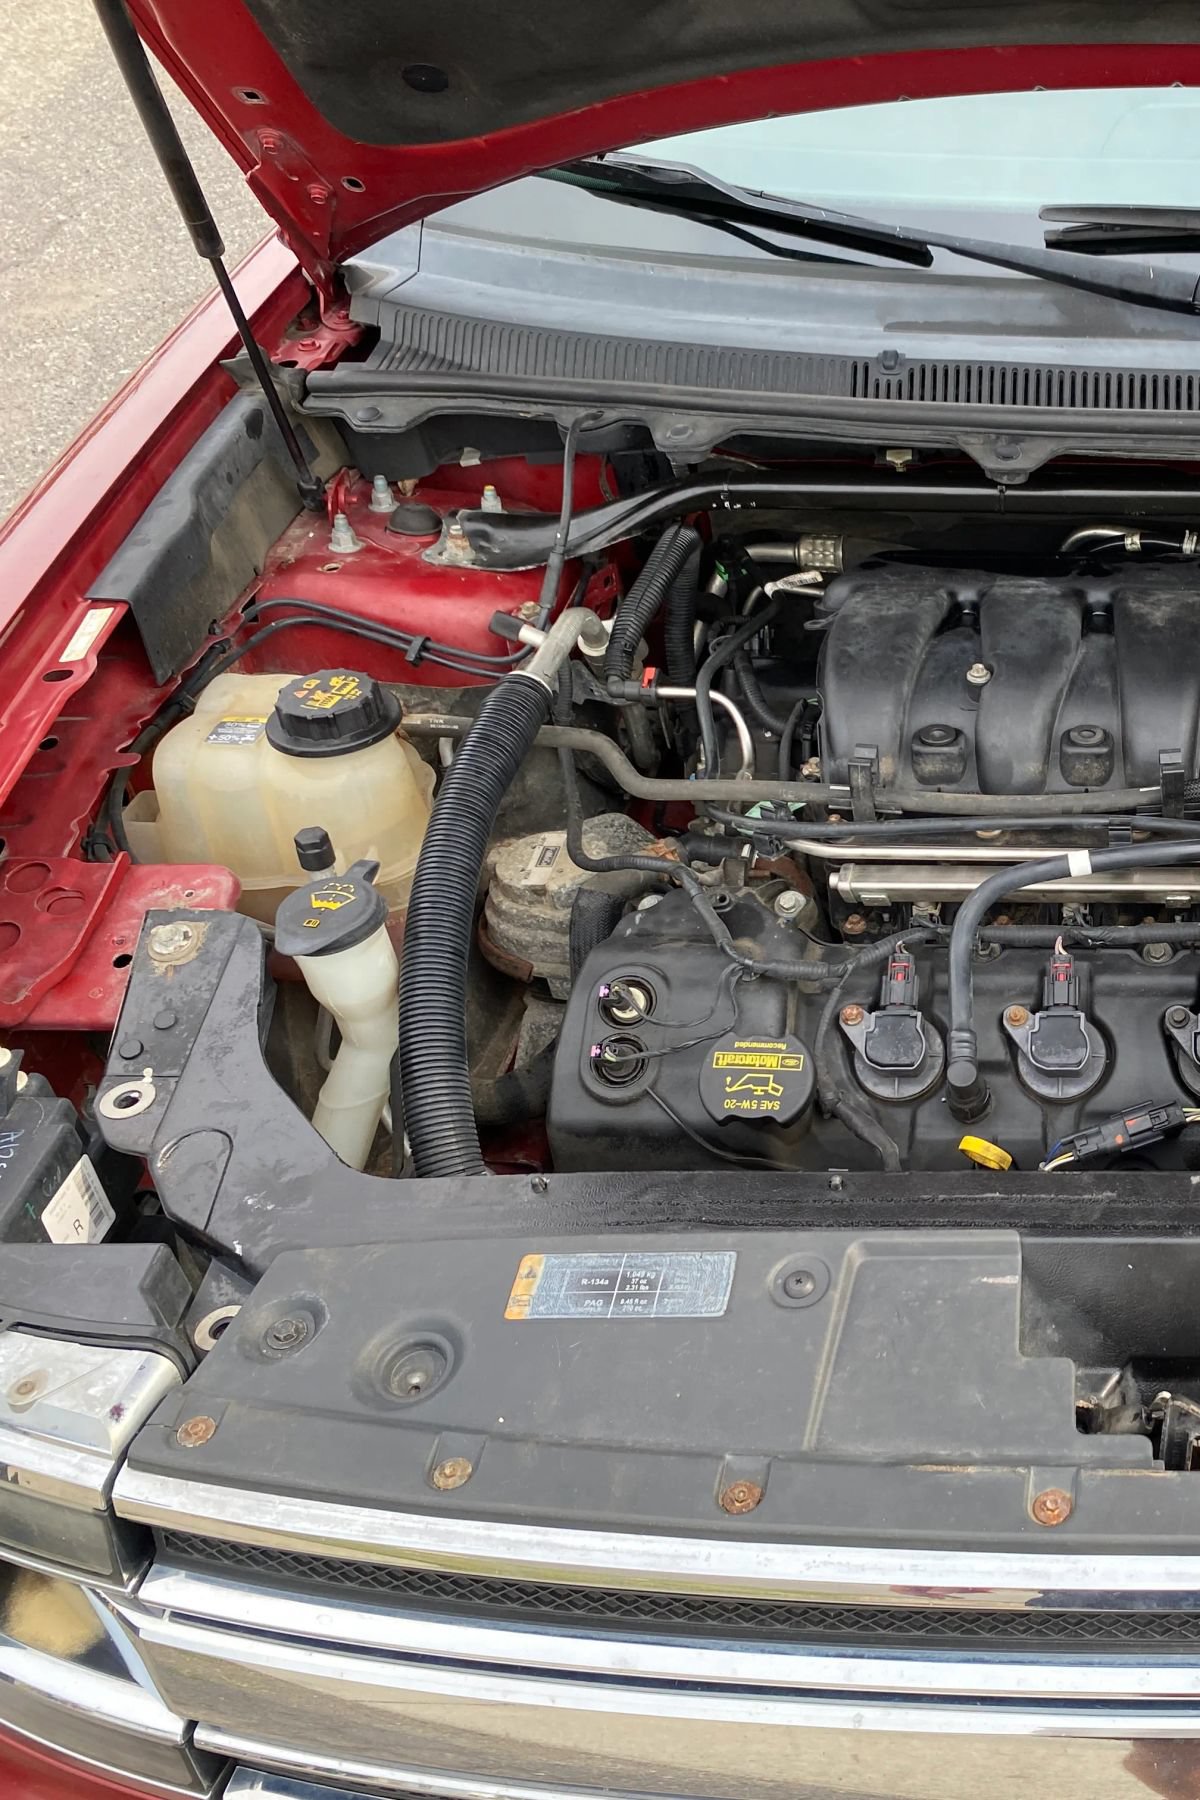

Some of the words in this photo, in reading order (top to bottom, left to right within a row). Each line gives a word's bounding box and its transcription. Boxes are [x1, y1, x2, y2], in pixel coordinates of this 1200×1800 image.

[735, 1041, 786, 1050] Recommended
[718, 1054, 778, 1067] Motorcraft
[723, 1099, 758, 1110] 5W-20
[759, 1100, 781, 1111] SAE
[73, 1218, 84, 1236] R
[581, 1278, 609, 1286] R-134a
[583, 1299, 604, 1307] PAG
